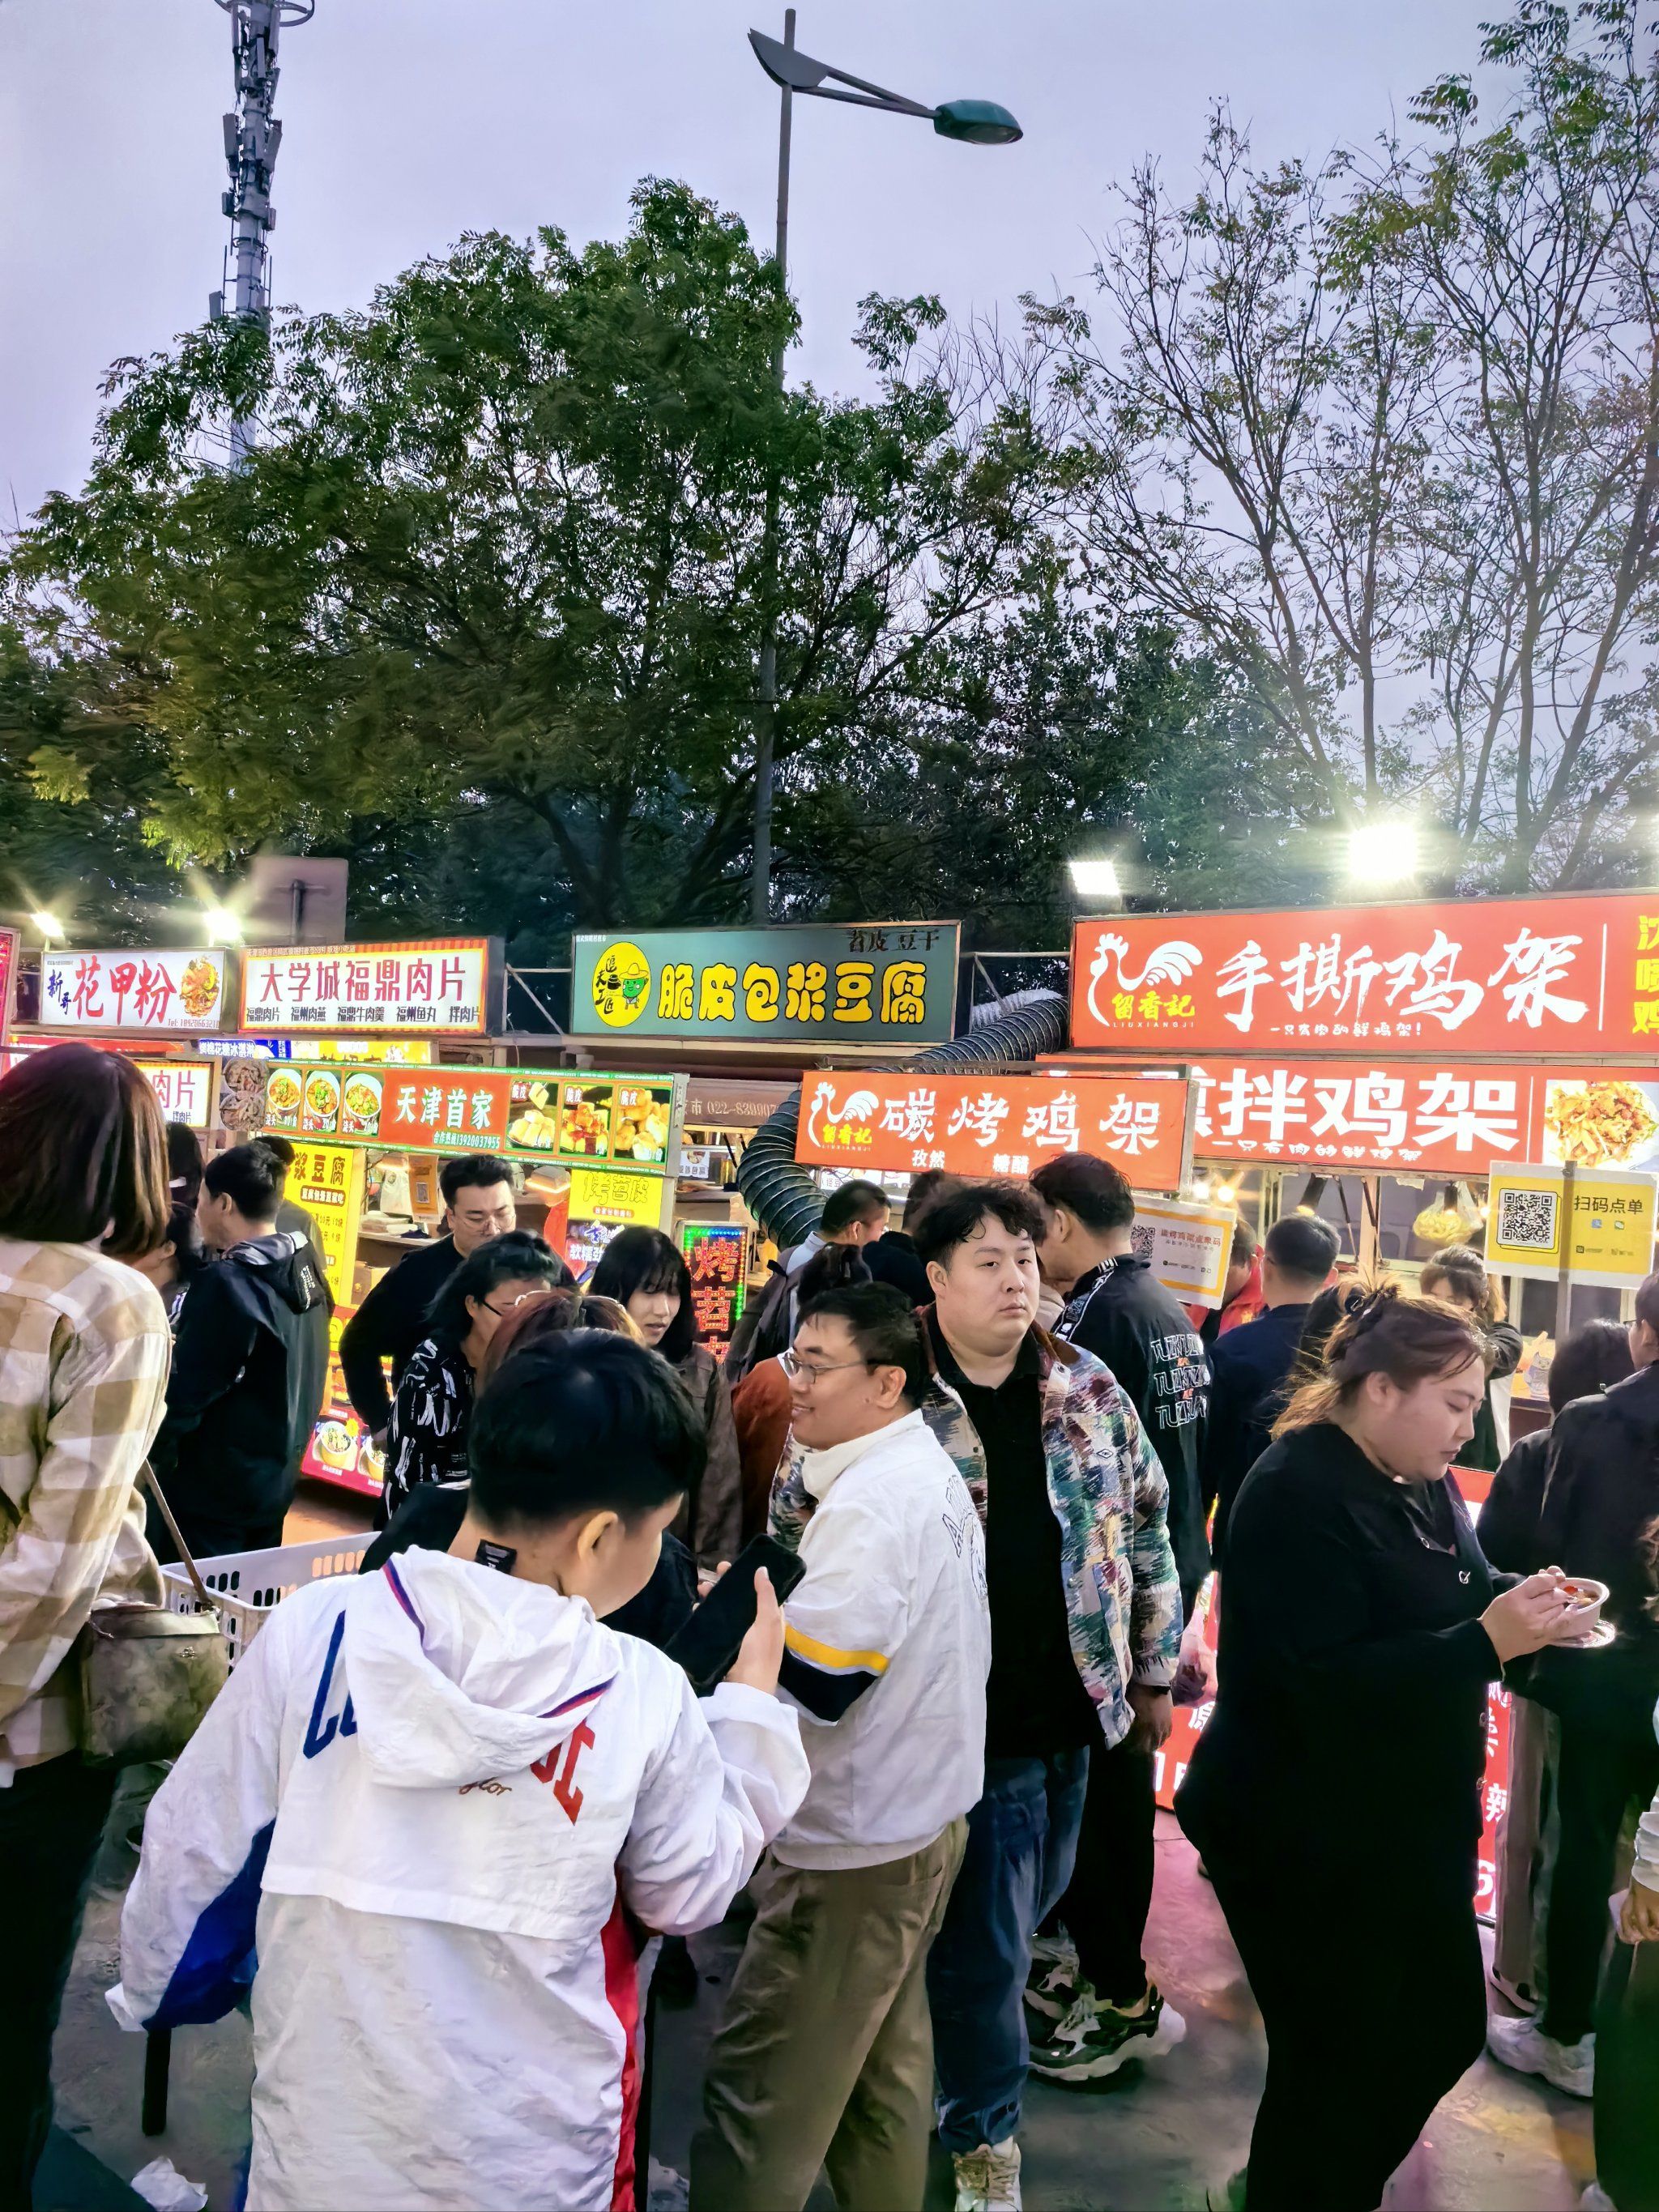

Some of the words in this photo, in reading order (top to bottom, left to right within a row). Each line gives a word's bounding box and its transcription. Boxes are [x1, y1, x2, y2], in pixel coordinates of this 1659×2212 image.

[73, 955, 177, 1025] 花甲粉
[260, 957, 466, 1002] 大学城福鼎肉片
[658, 961, 928, 1025] 脆皮包浆豆腐
[1216, 928, 1590, 1032] 手撕鸡架
[246, 1007, 280, 1022] 福鼎肉片
[291, 1006, 326, 1022] 福州肉燕
[337, 1006, 385, 1022] 福鼎牛肉羹
[396, 1006, 437, 1022] 福州鱼丸
[396, 1085, 493, 1129] 天津首家
[879, 1088, 1161, 1156] 碳烤鸡架
[911, 1149, 945, 1169] 孜然
[1573, 1195, 1644, 1214] 扫码点单
